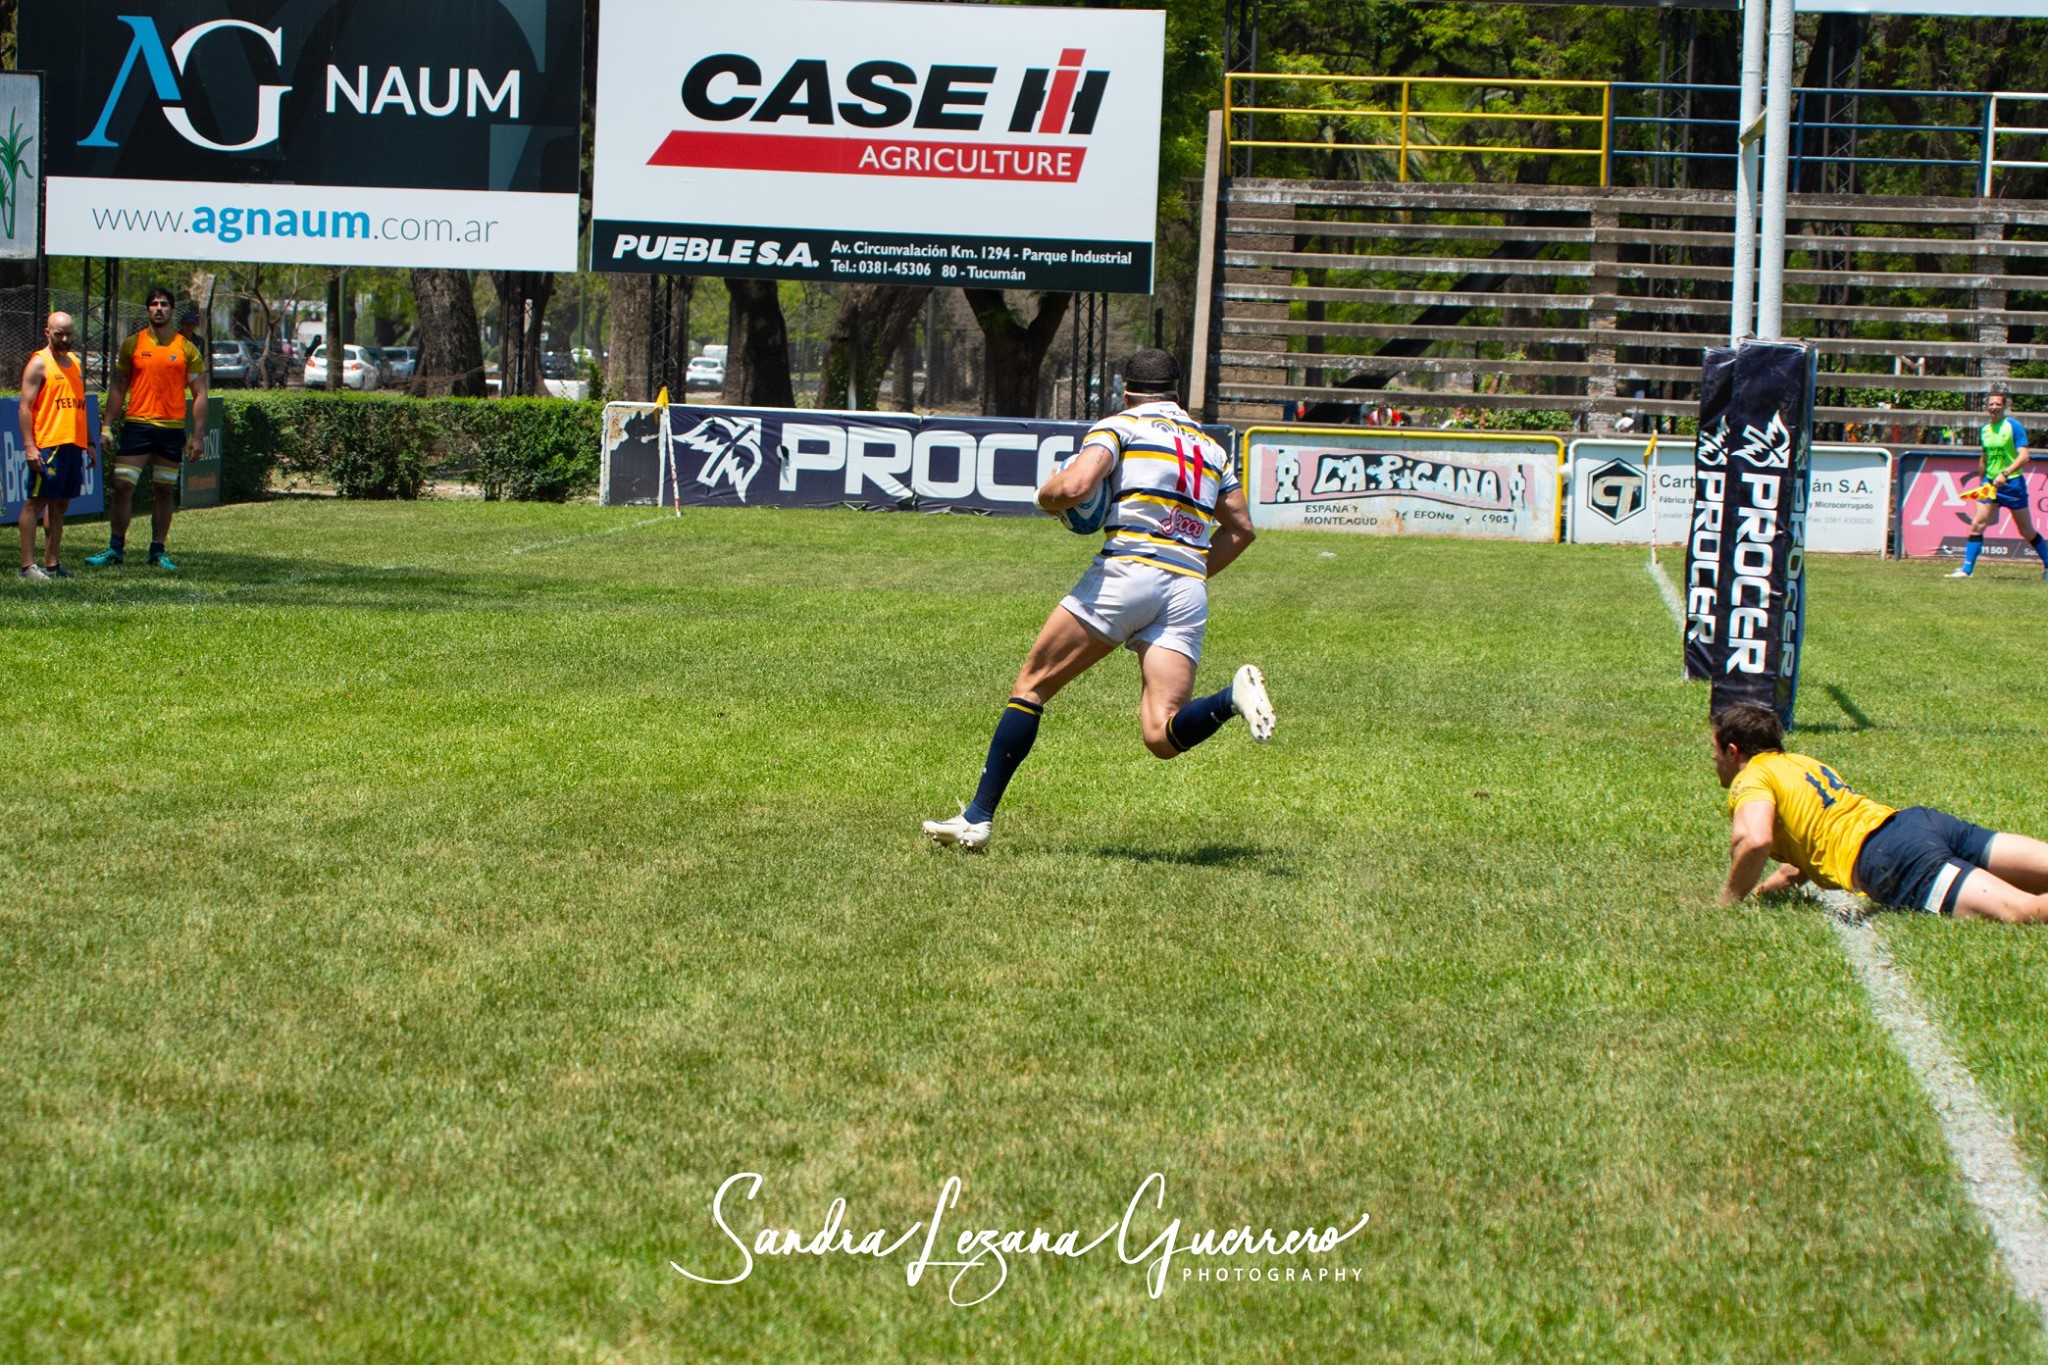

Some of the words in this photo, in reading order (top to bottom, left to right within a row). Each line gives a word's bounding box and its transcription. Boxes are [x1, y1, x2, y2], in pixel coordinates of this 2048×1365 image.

[325, 64, 521, 118] NAUM
[682, 53, 998, 131] CASE
[858, 144, 1072, 178] AGRICULTURE
[92, 206, 499, 244] www.agnaum.com.ar
[612, 234, 754, 264] PUEBLE
[756, 240, 820, 268] S.A.
[831, 240, 851, 254] Av.
[854, 241, 948, 258] Circunvalación
[951, 245, 978, 259] Km.
[982, 246, 1011, 260] 1294
[1022, 248, 1068, 265] Parque
[1071, 250, 1132, 265] Industrial
[831, 259, 857, 273] Tel.:
[941, 265, 957, 279] 80
[967, 266, 1026, 281] Tucumán
[1174, 435, 1204, 500] 11
[1839, 479, 1873, 493] S.A.
[1815, 501, 1874, 510] Microcorrugado
[1686, 470, 1727, 645] PROCER
[1726, 472, 1781, 674] PROCER
